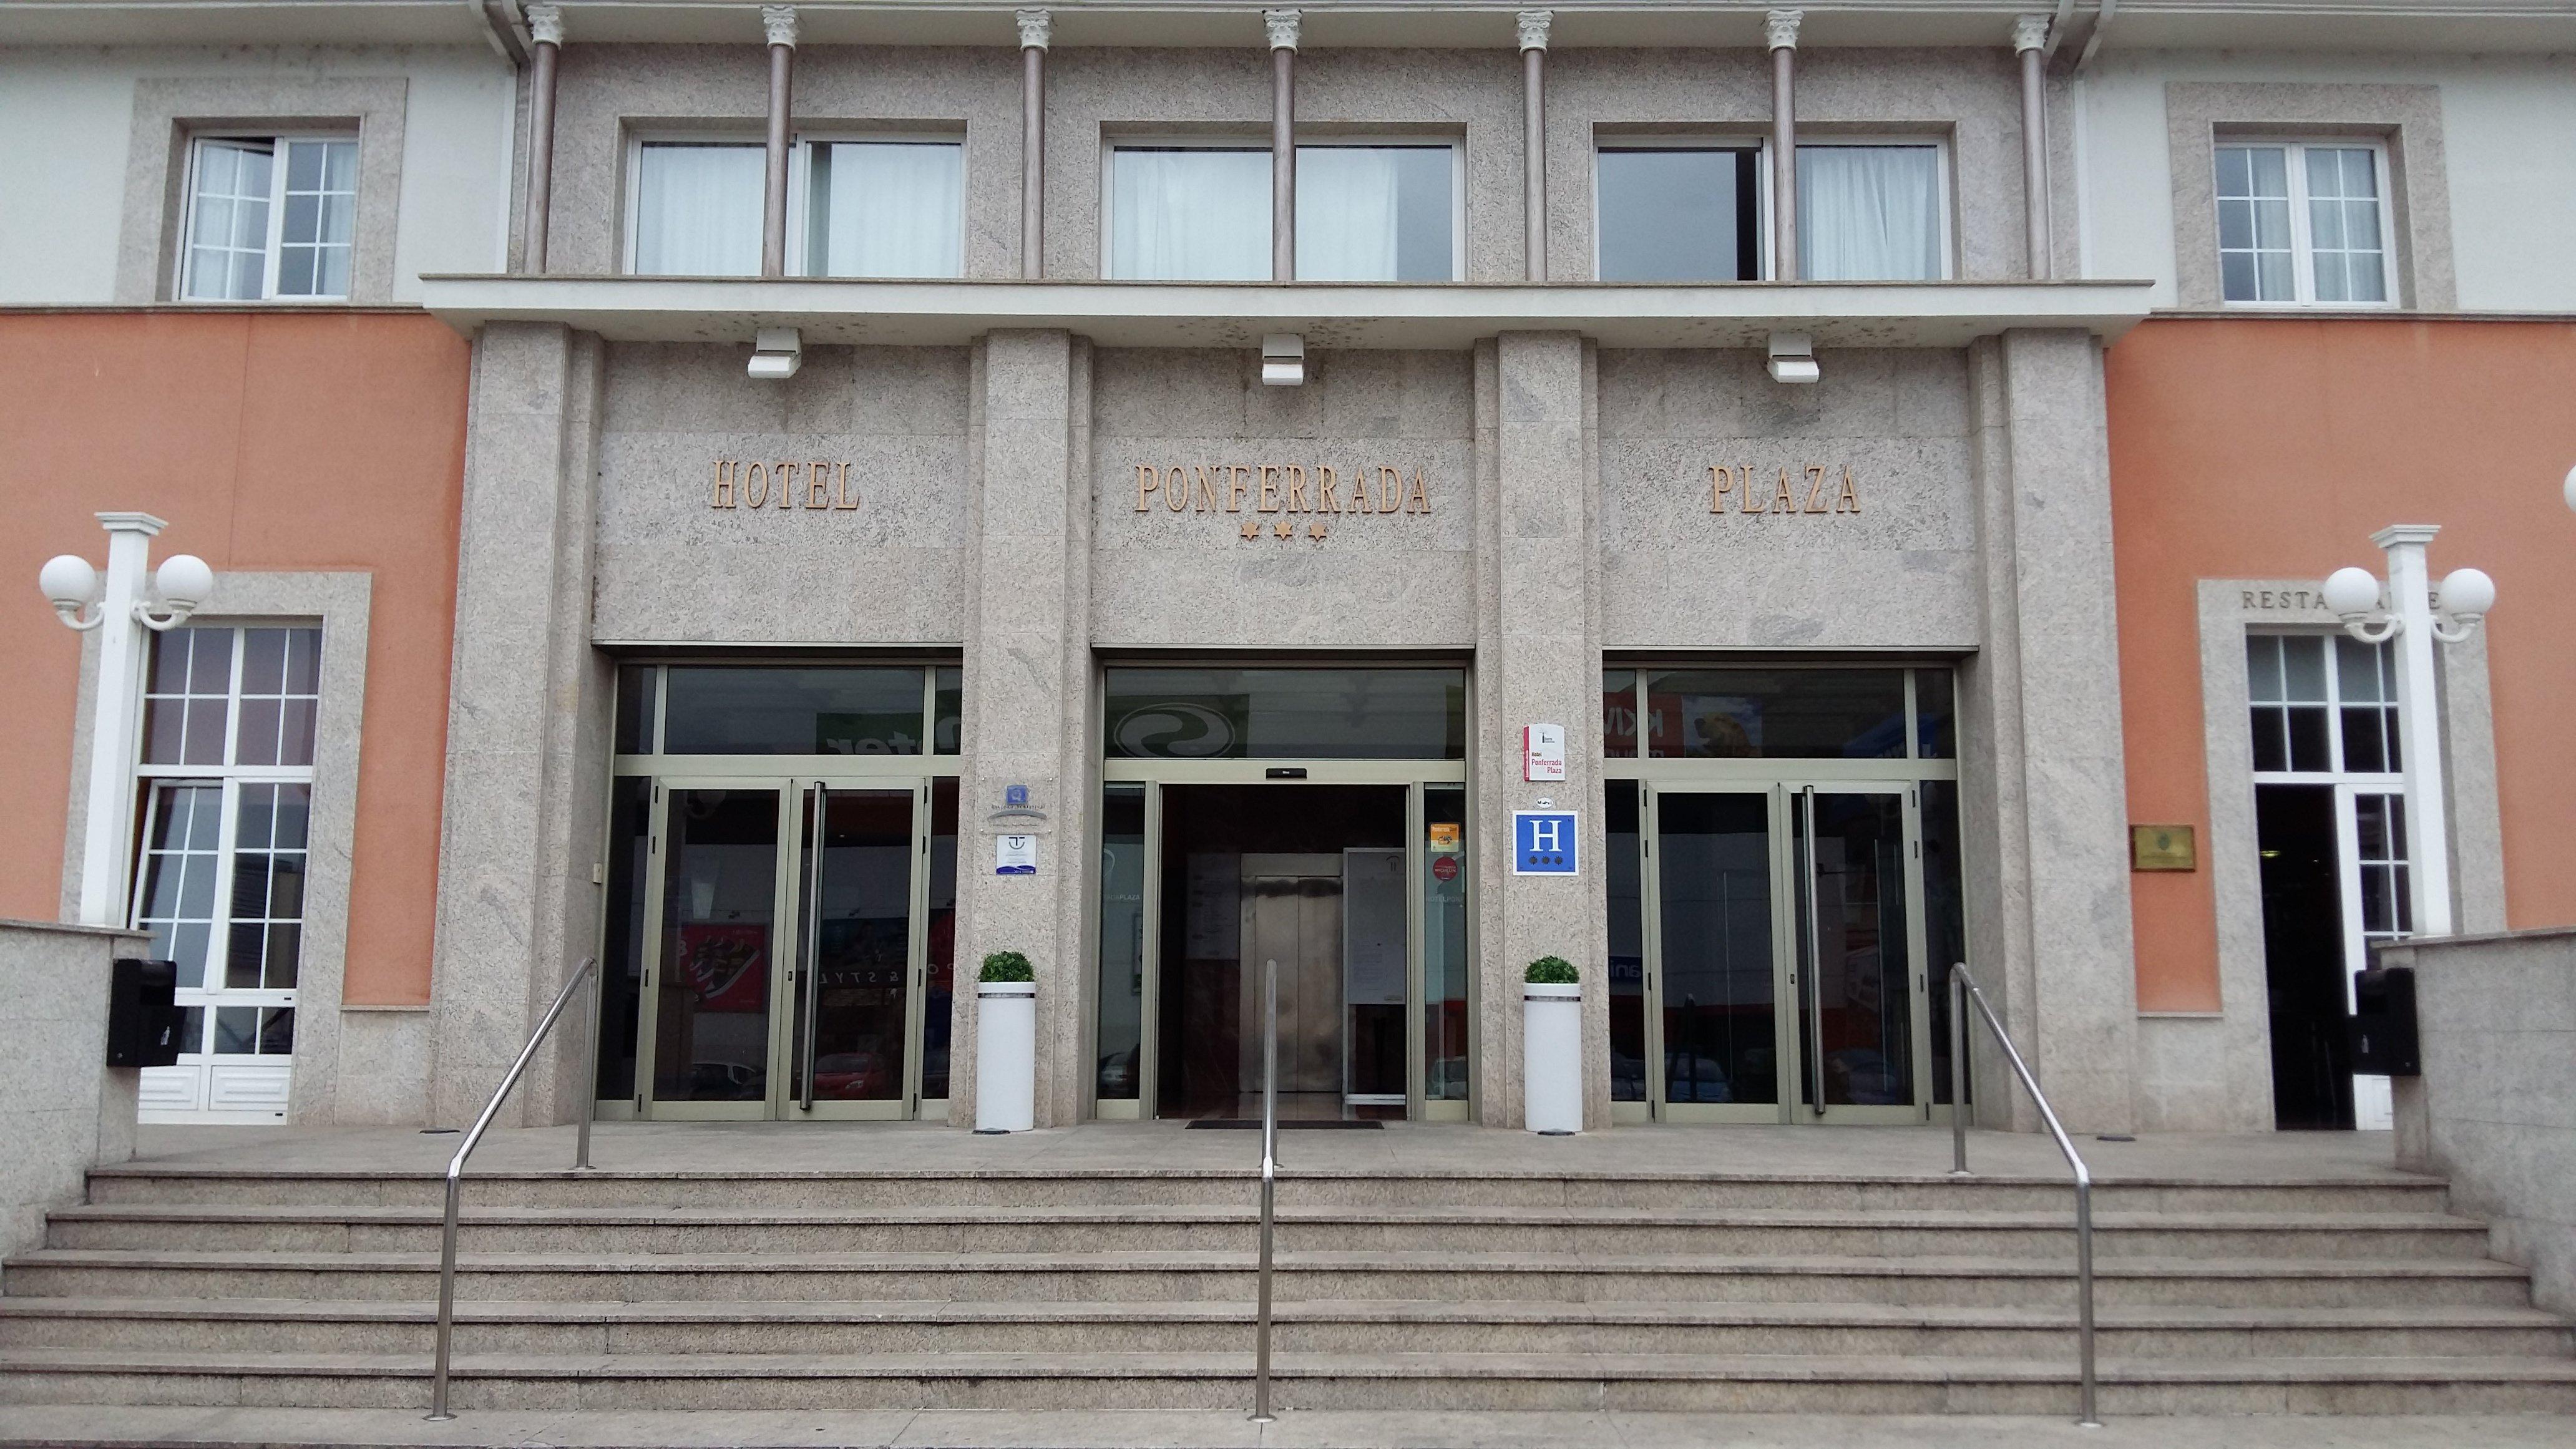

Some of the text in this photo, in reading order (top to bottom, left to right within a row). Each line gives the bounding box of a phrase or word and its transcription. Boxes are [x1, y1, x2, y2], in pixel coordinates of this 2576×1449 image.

[711, 460, 860, 509] HOTEL
[1135, 464, 1432, 513] PONFERRADA
[1709, 465, 1861, 513] PLAZA
[1529, 819, 1563, 852] H
